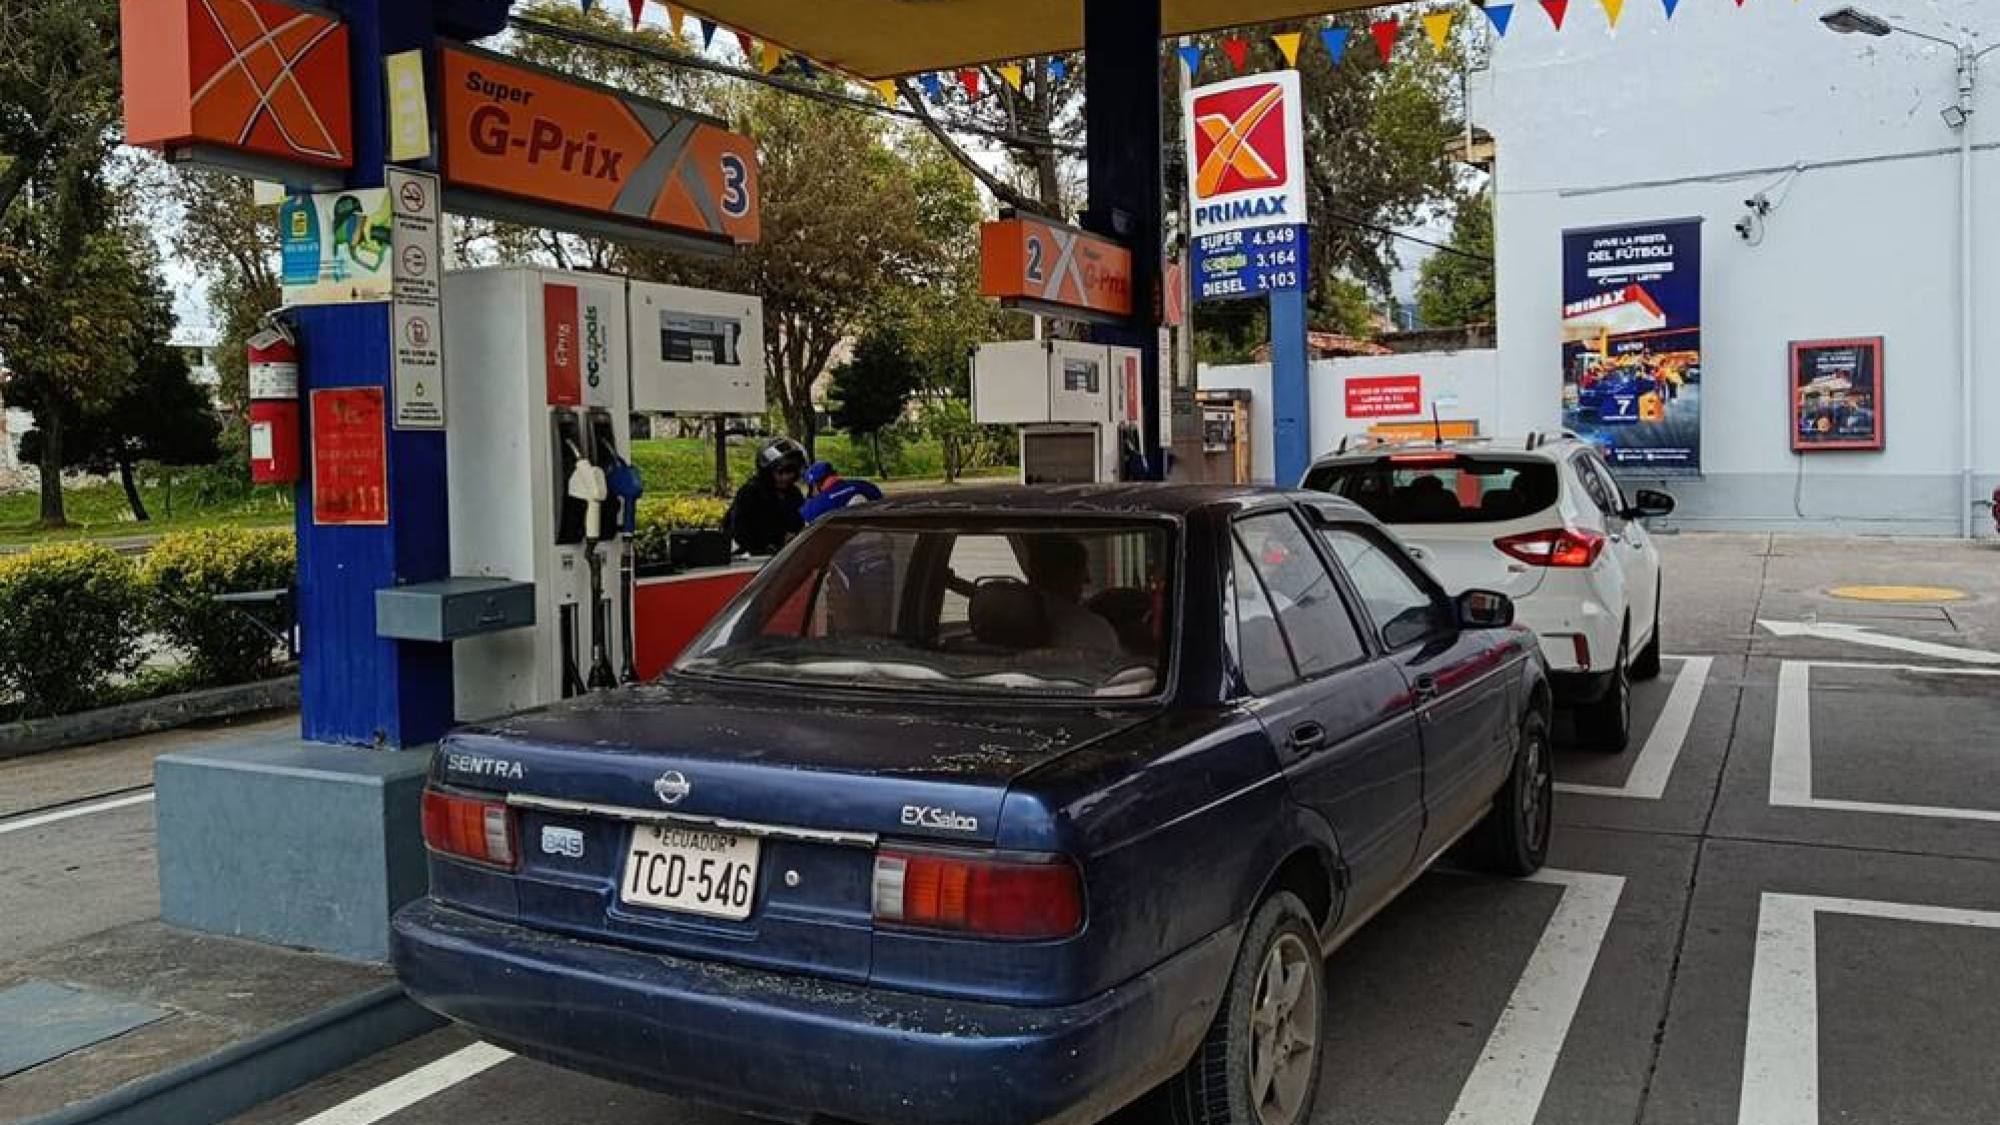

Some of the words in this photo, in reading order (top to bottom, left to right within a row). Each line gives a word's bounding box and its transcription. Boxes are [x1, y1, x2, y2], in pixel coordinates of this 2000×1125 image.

[466, 71, 534, 105] Super
[468, 105, 623, 182] G-Prix
[720, 151, 748, 217] 3
[1195, 195, 1288, 226] PRIMAX
[1201, 232, 1244, 250] SUPER
[1026, 236, 1043, 283] 2
[1256, 250, 1296, 267] 3.164
[1587, 250, 1614, 262] DEL
[1202, 278, 1247, 297] DIESEL
[1566, 290, 1625, 316] PRIMAX
[1617, 400, 1630, 416] 7
[448, 754, 523, 779] SENTRA
[662, 835, 727, 851] ECUADOR
[632, 851, 750, 908] TCD-546
